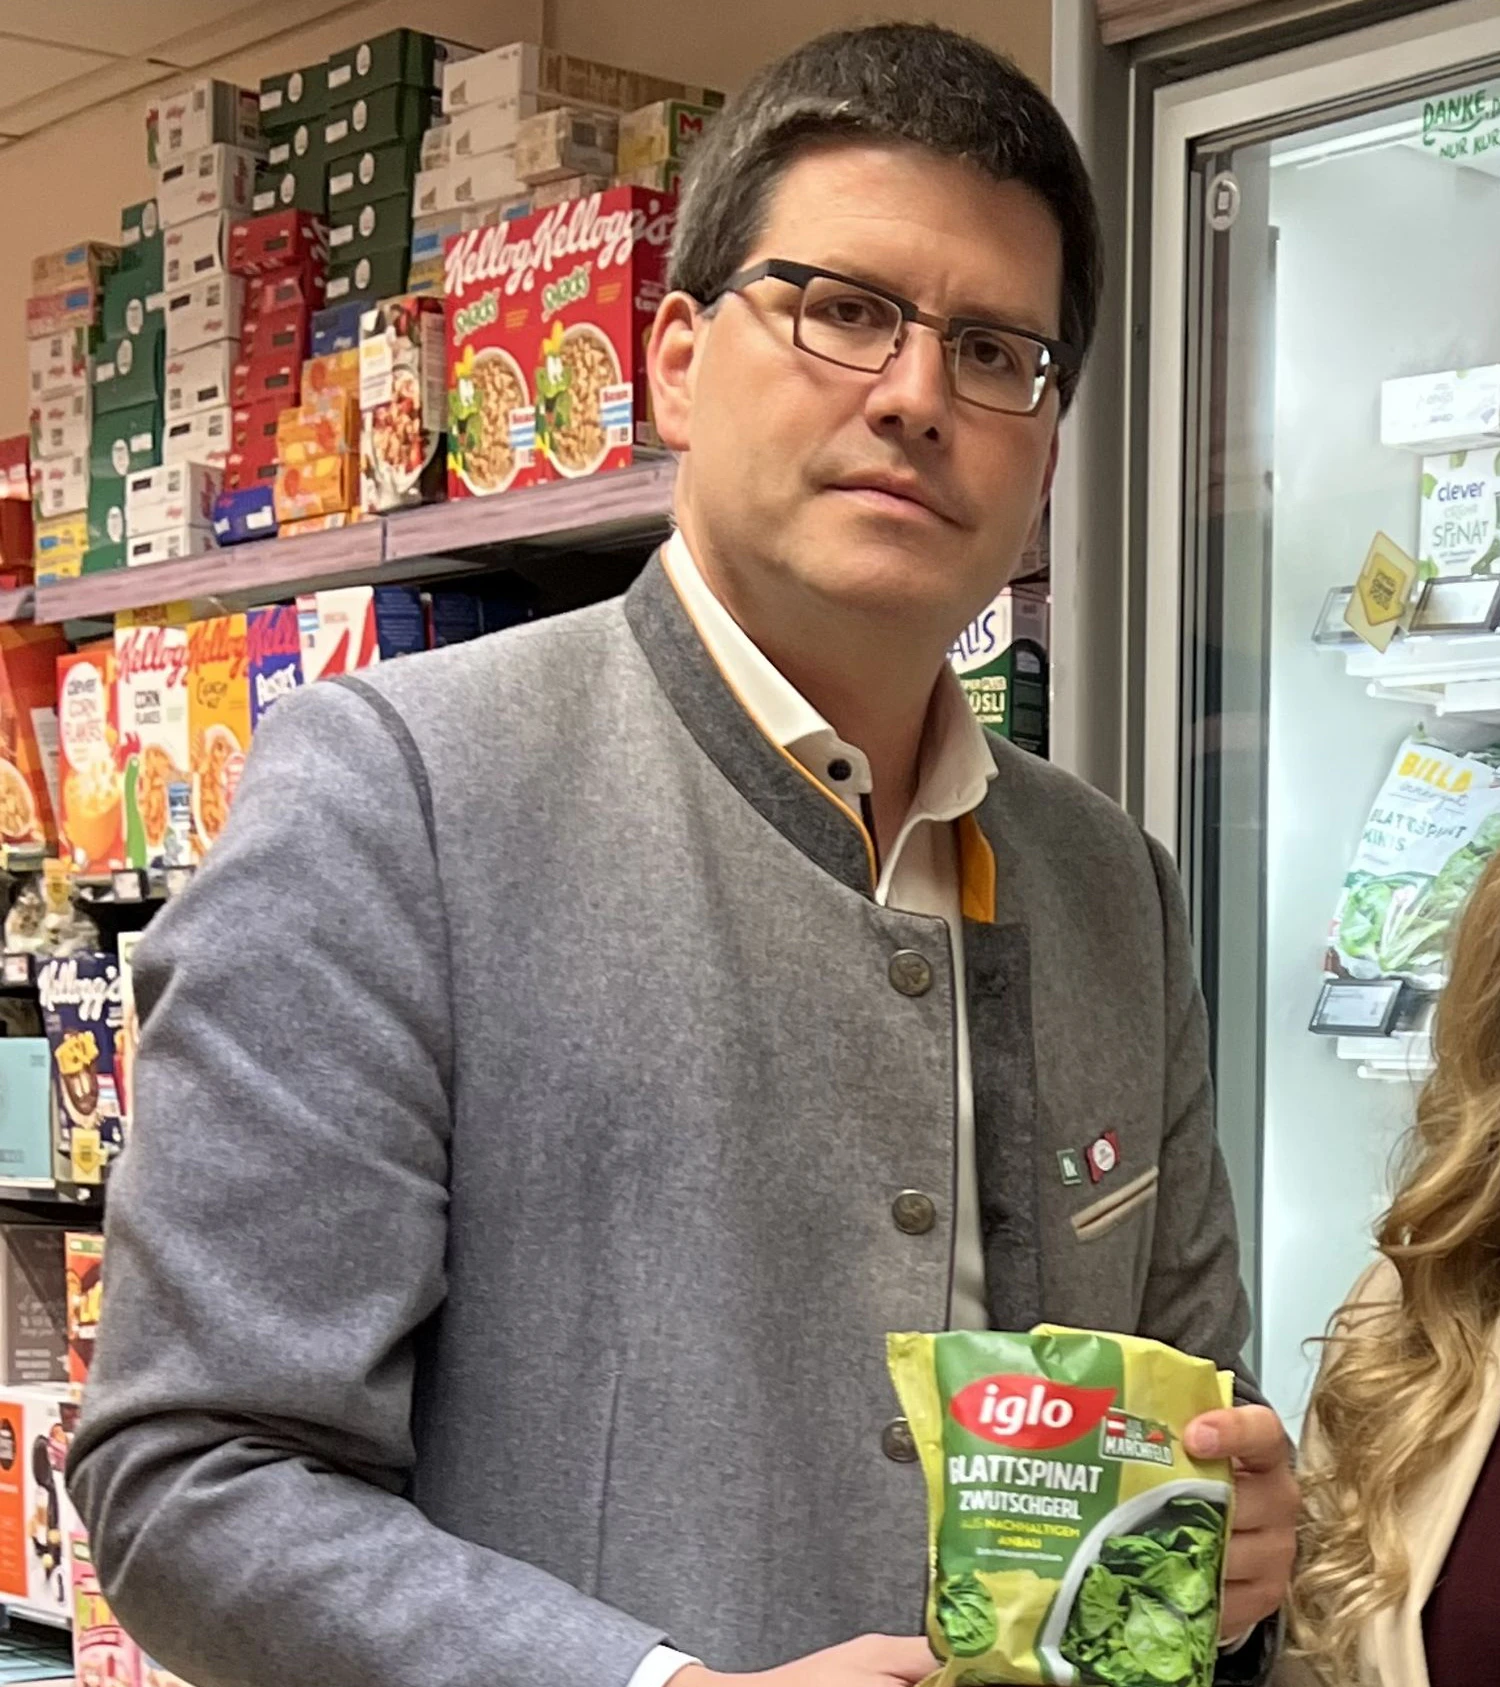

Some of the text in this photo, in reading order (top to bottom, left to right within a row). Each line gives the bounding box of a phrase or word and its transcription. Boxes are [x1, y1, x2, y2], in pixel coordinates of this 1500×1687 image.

[1440, 137, 1468, 158] NUR
[1438, 480, 1486, 502] clever
[1432, 519, 1489, 549] SPINAT
[1397, 750, 1473, 794] BILLA
[978, 1383, 1074, 1436] iglo
[949, 1454, 1103, 1495] BLATTSPINAT
[959, 1489, 1083, 1520] ZWUTSCHGERL
